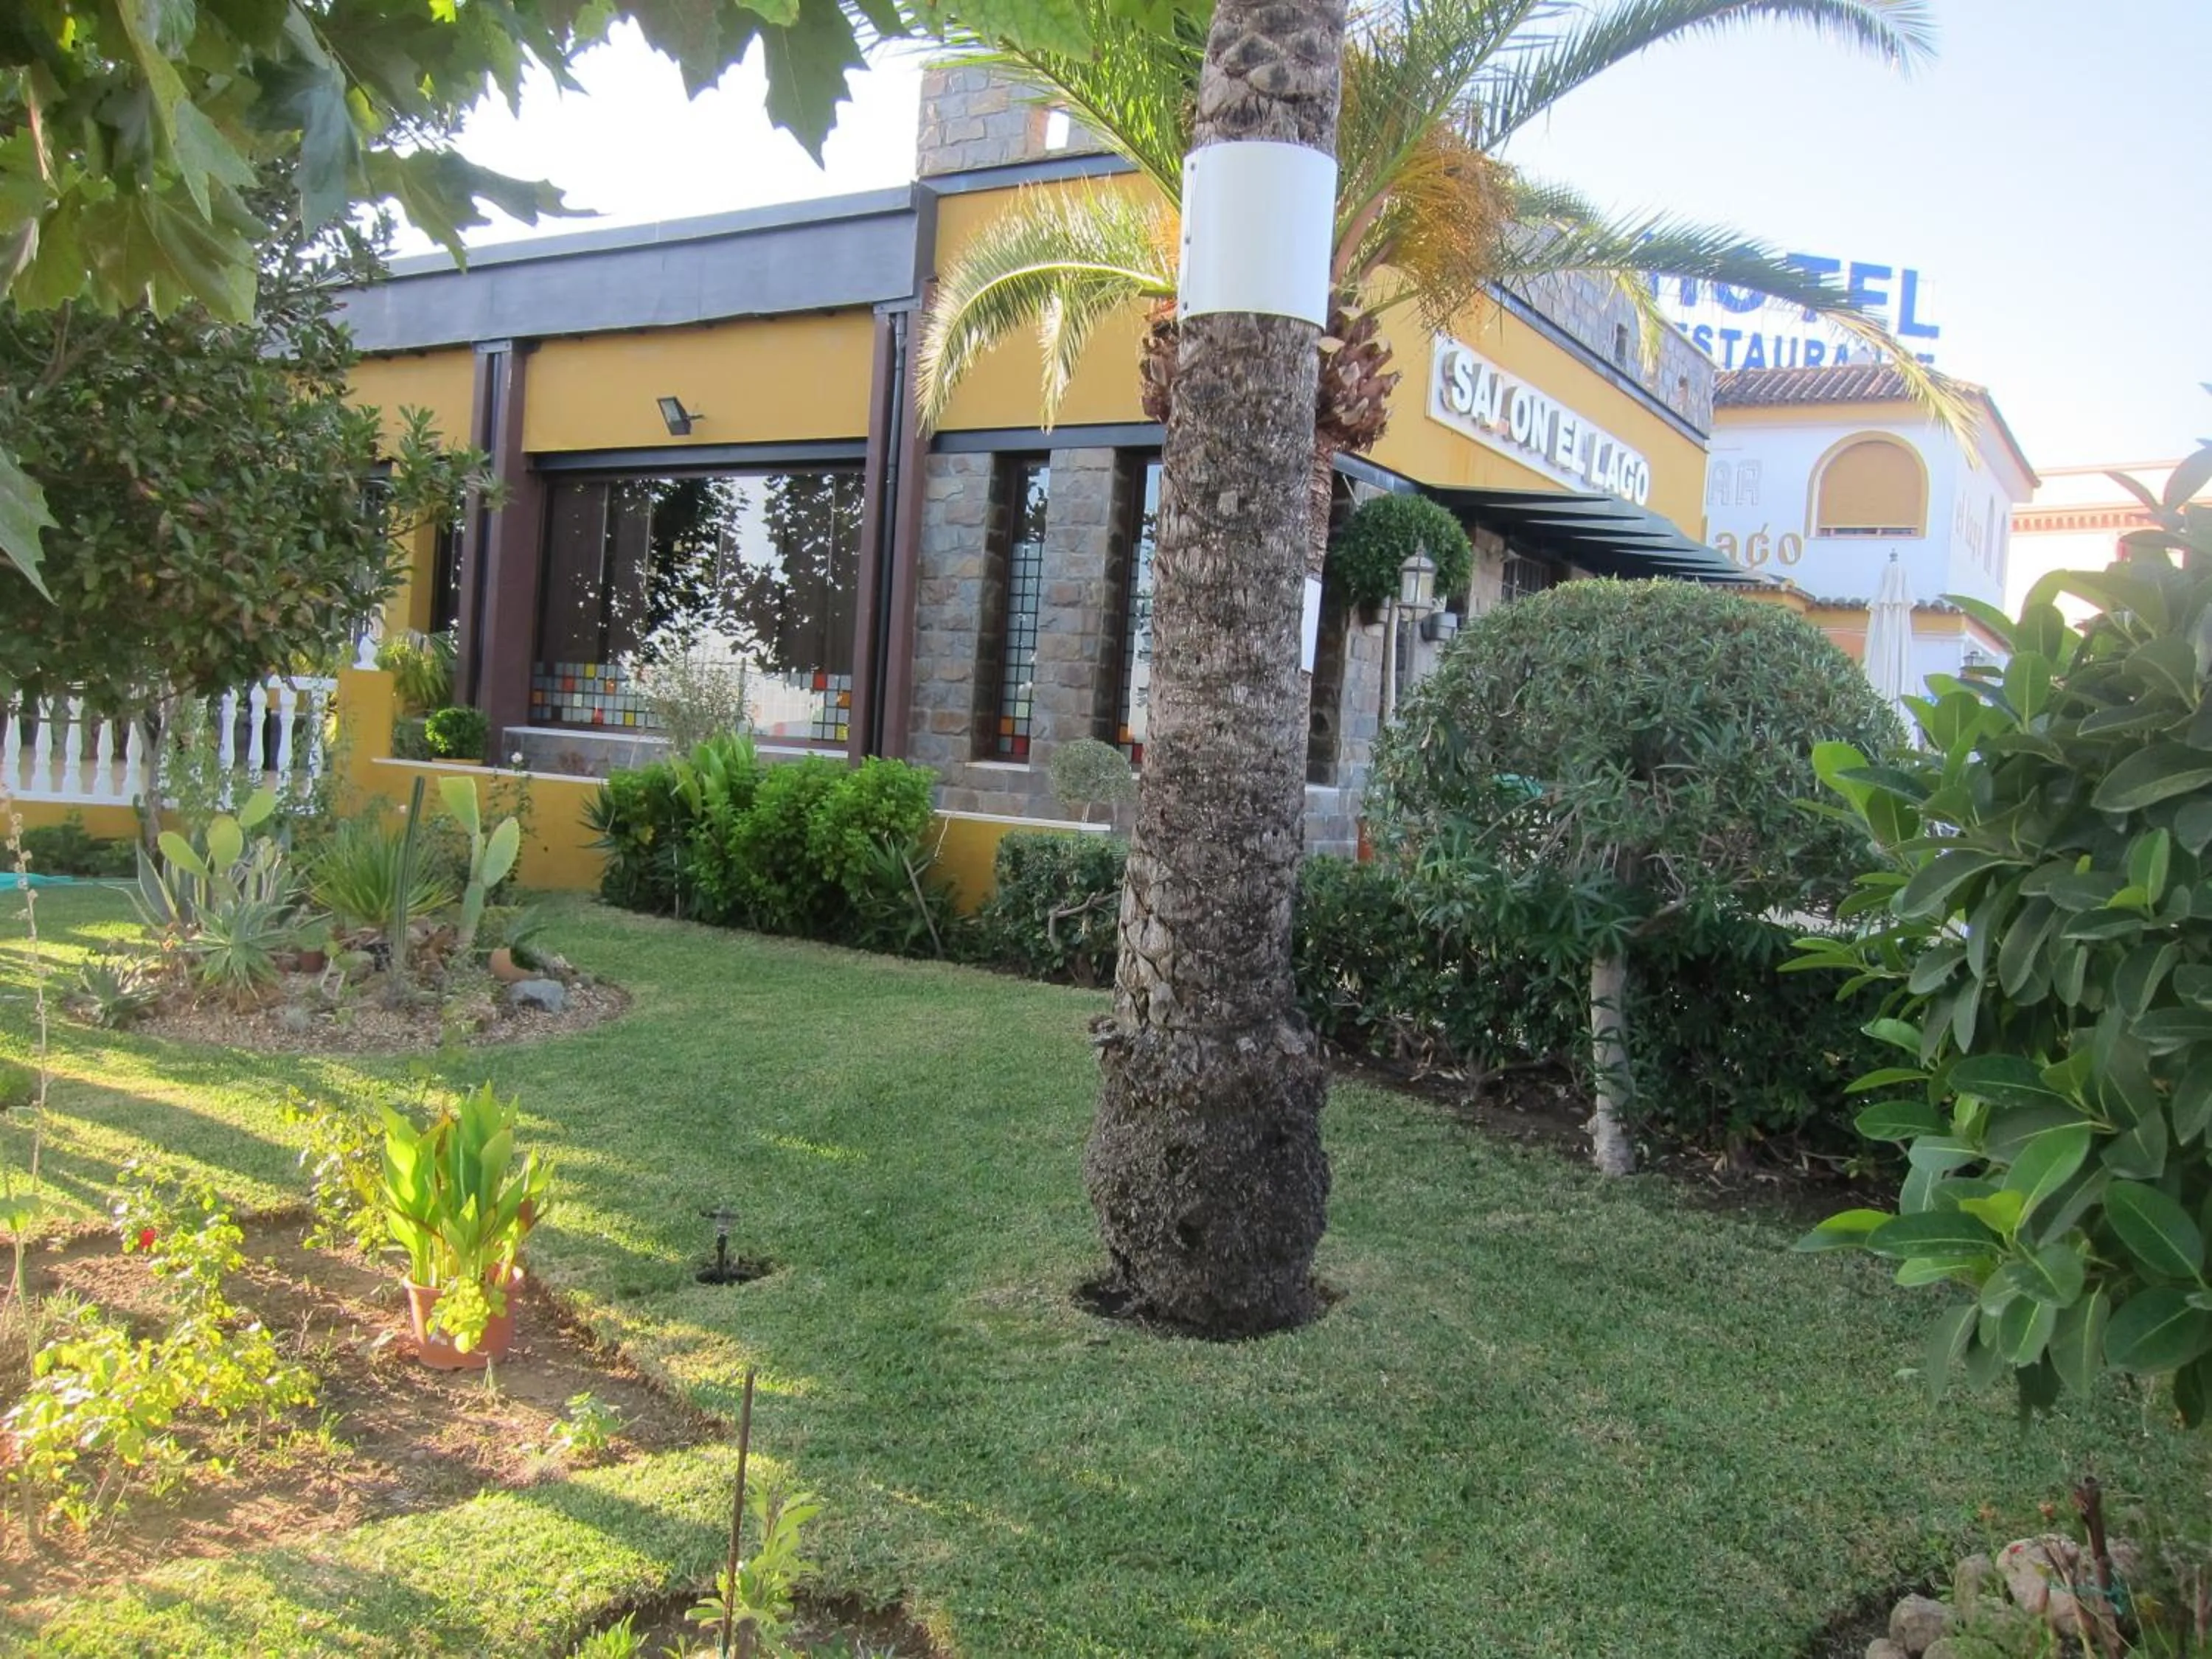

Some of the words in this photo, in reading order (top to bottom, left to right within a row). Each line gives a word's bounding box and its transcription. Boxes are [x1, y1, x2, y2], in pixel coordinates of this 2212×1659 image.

[1450, 350, 1551, 454] SALON
[1555, 411, 1585, 475] EL
[1590, 431, 1650, 507] LAGO
